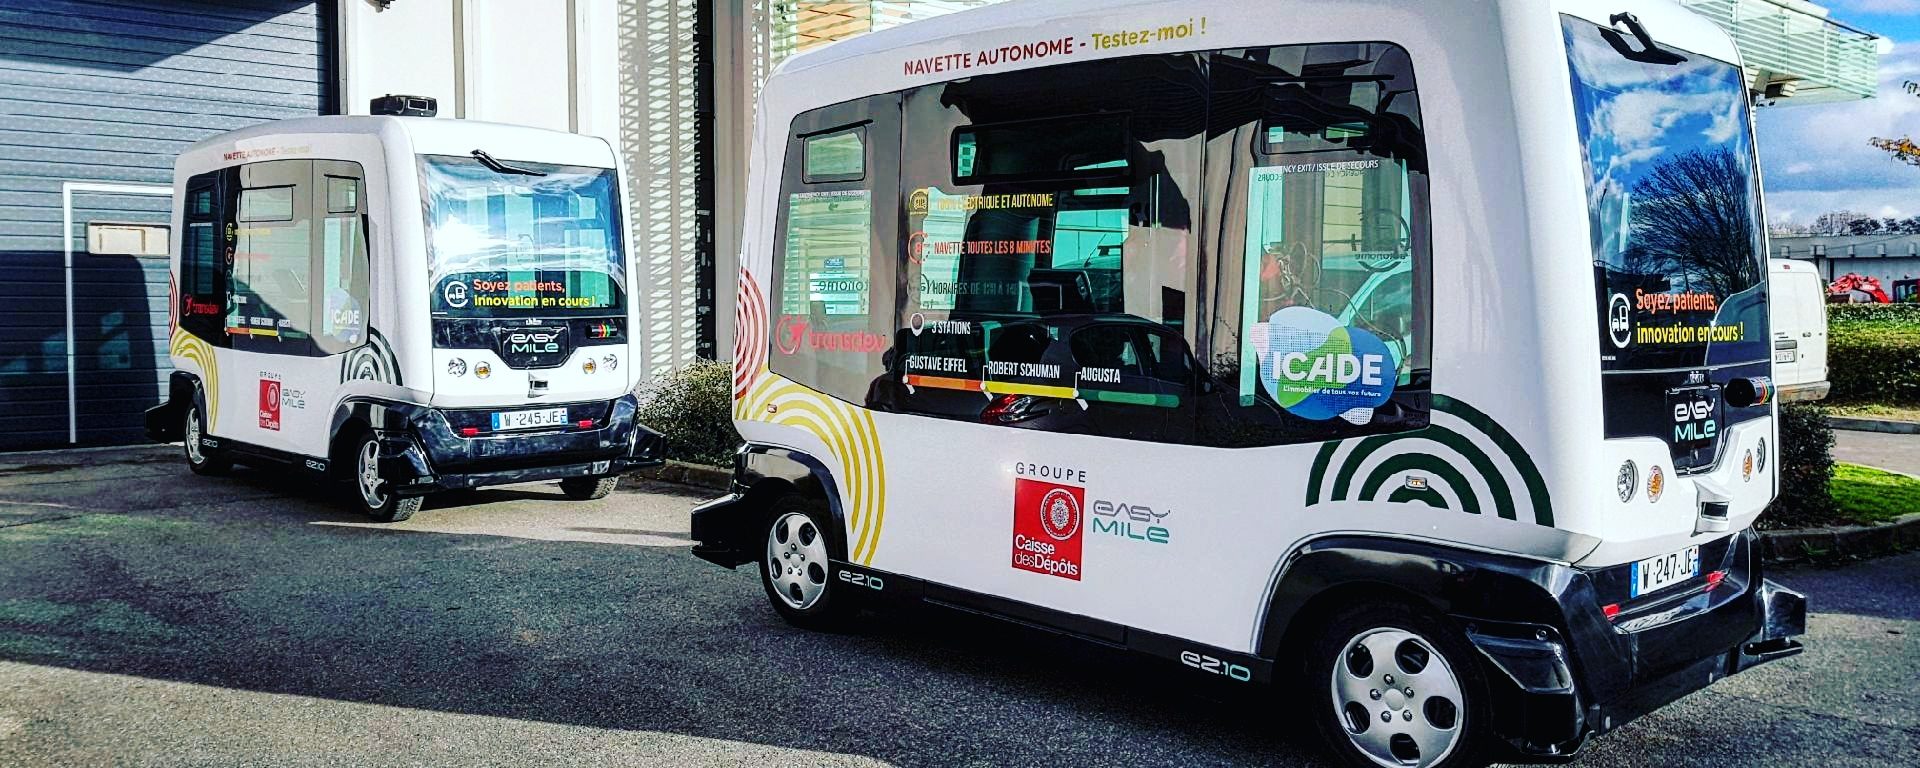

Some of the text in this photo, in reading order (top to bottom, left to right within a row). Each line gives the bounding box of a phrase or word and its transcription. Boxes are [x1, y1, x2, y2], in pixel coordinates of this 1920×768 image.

[904, 52, 972, 76] NAVETTE
[976, 36, 1074, 67] AUTONOME
[1091, 18, 1194, 50] Testez-moi
[1297, 163, 1312, 172] EXIT
[1346, 159, 1379, 171] SECOURS
[1001, 194, 1011, 208] ET
[1011, 193, 1053, 208] AUTONOME
[934, 241, 966, 255] NAVETTE
[967, 241, 993, 255] TOUTES
[994, 241, 1008, 254] LES
[1016, 240, 1051, 254] MINUTES
[473, 278, 566, 294] Soyez patients,
[934, 280, 969, 295] HORAIRES
[474, 294, 539, 307] innovation
[543, 296, 556, 307] en
[560, 296, 590, 307] cours
[1635, 287, 1719, 315] Soyez patients,
[931, 320, 971, 335] 3 STATIONS
[1636, 321, 1695, 344] innovation
[1697, 325, 1710, 343] en
[1711, 324, 1738, 342] cours
[808, 329, 887, 353] transdev
[909, 355, 968, 373] GUSTAVE EIFFEL
[988, 360, 1060, 379] ROBERT SCHUMAN
[1272, 350, 1383, 386] ICADE
[1080, 366, 1121, 384] AUGUSTA
[1321, 386, 1330, 395] de
[1331, 388, 1346, 396] tous
[1015, 461, 1087, 483] GROUPE
[1015, 534, 1055, 555] Caisse
